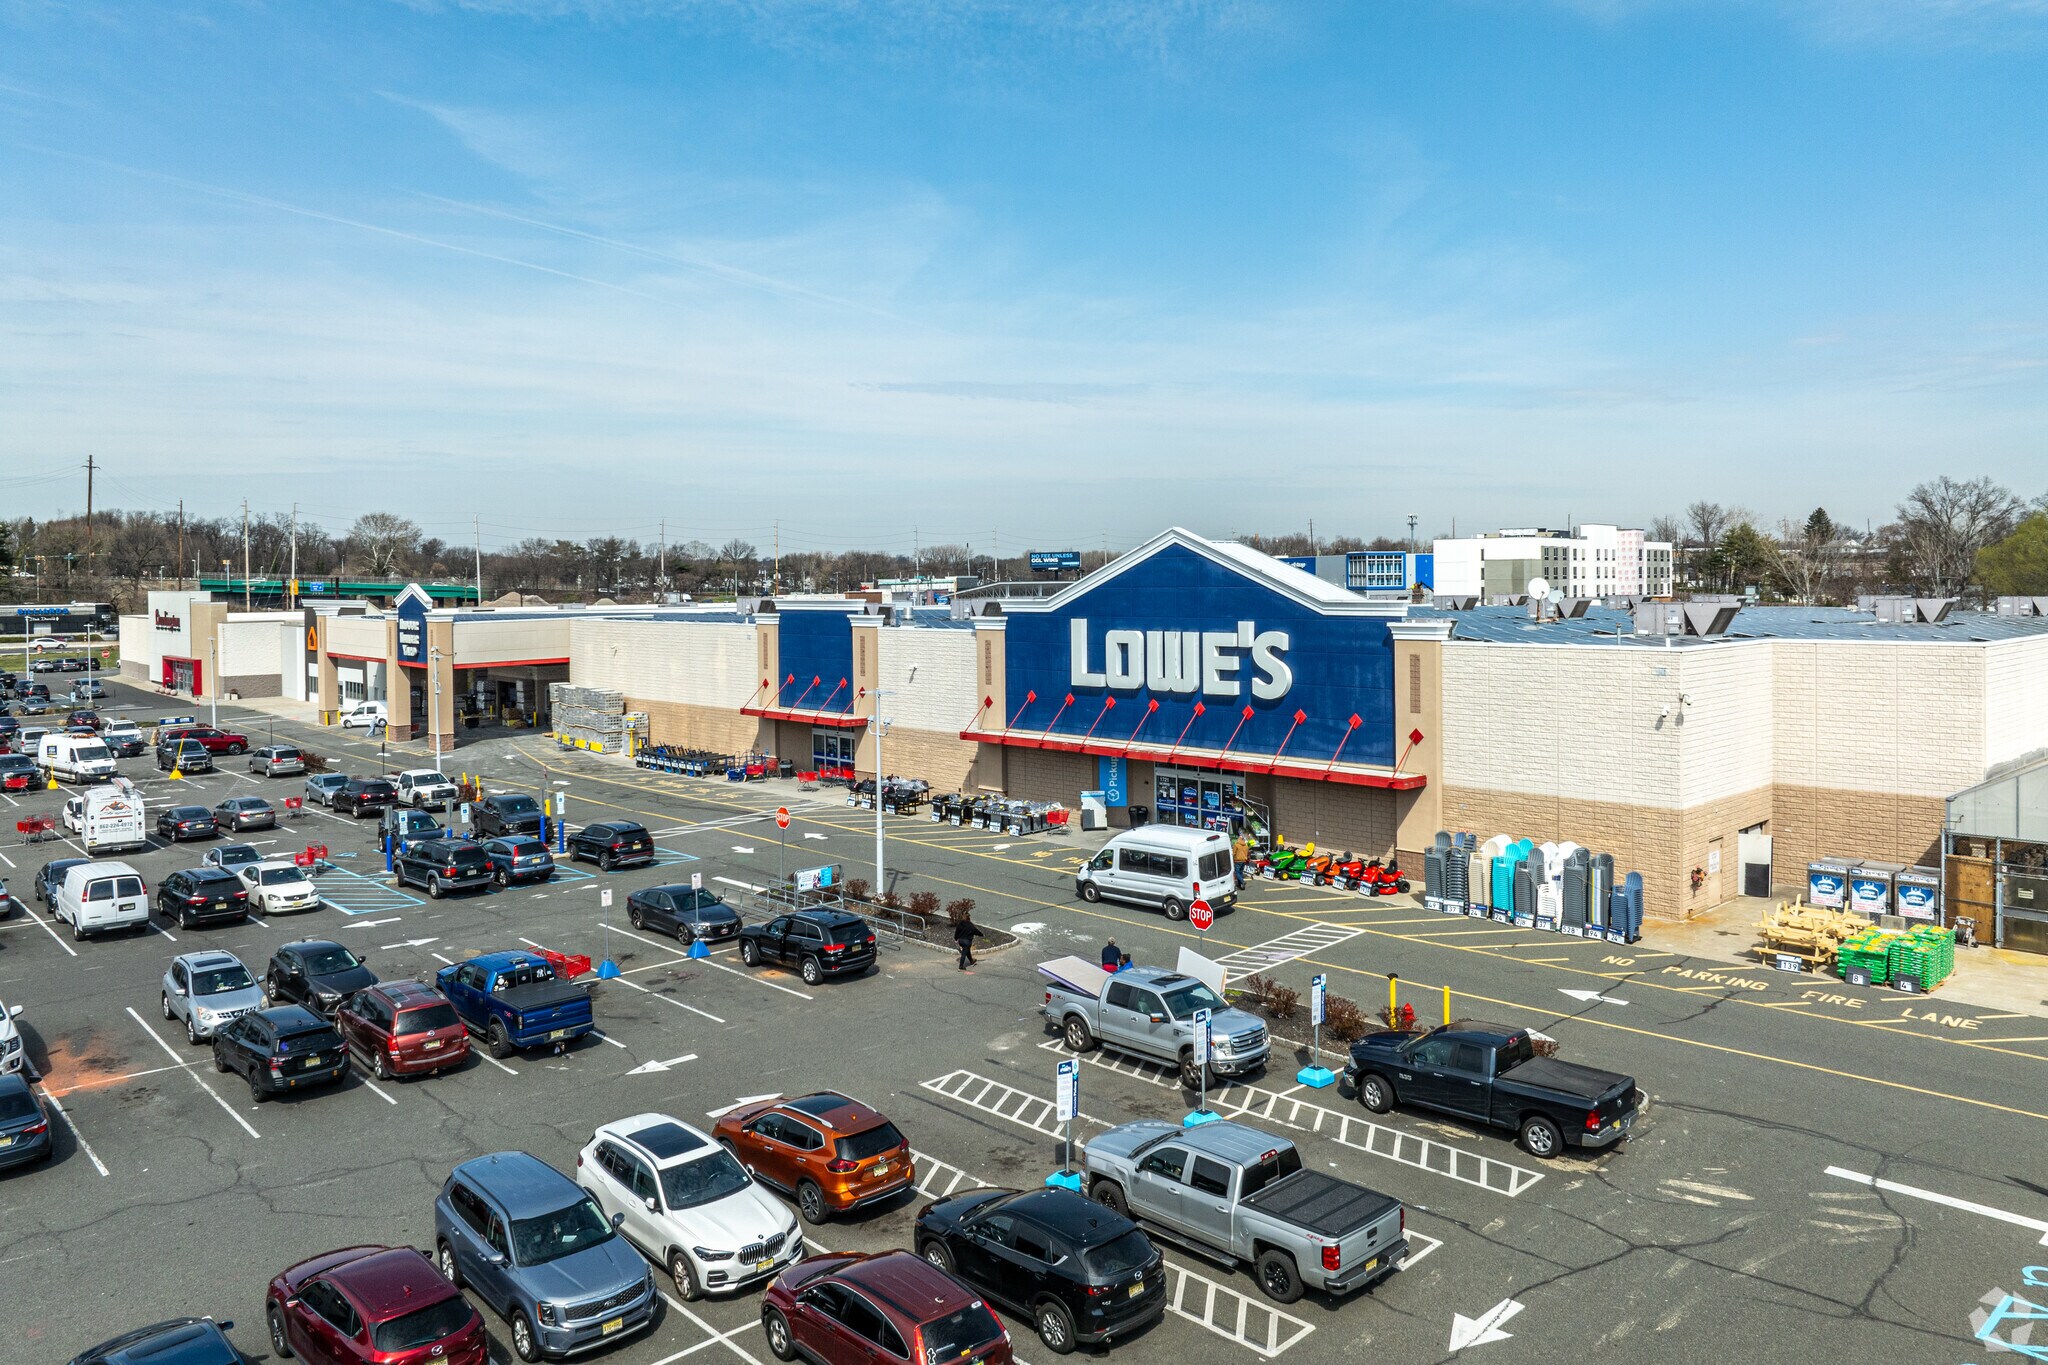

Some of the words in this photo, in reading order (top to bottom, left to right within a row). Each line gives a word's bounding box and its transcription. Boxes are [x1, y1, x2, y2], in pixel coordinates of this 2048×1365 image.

[1070, 618, 1293, 700] LOWE'S
[1109, 756, 1119, 787] Pickup
[777, 812, 790, 822] STOP
[1191, 907, 1212, 922] STOP
[1562, 925, 1576, 934] 528
[1783, 962, 1798, 970] 139
[1853, 973, 1859, 982] 8
[1601, 955, 1636, 967] NO
[1661, 965, 1770, 991] PARKING
[1800, 990, 1868, 1009] FIRE
[1901, 1007, 1984, 1030] LANE
